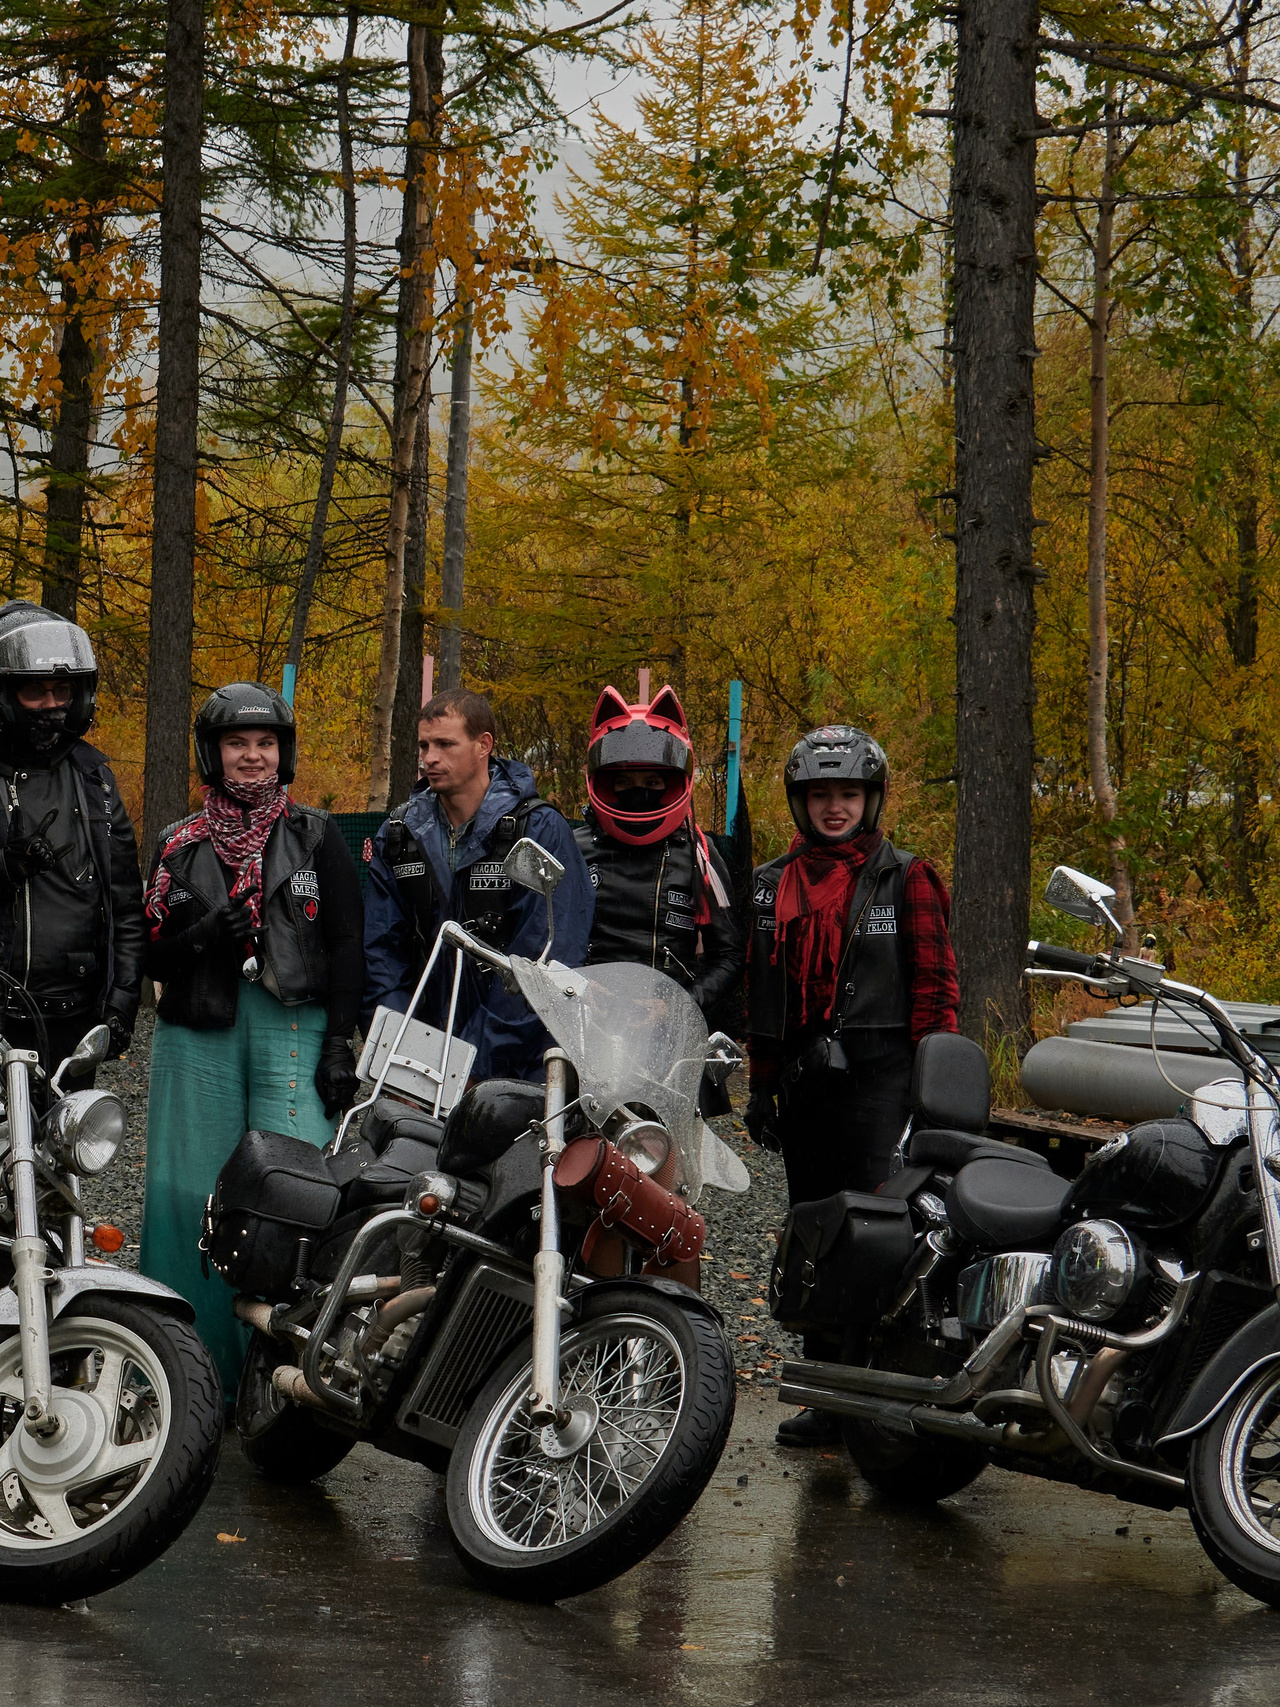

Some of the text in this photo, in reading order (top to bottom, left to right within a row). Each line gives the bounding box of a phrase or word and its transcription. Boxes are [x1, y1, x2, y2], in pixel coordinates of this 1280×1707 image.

[394, 864, 424, 877] PROSPECT
[472, 864, 505, 874] MAGADA
[471, 878, 511, 888] ПУТЯ
[754, 887, 775, 903] 49
